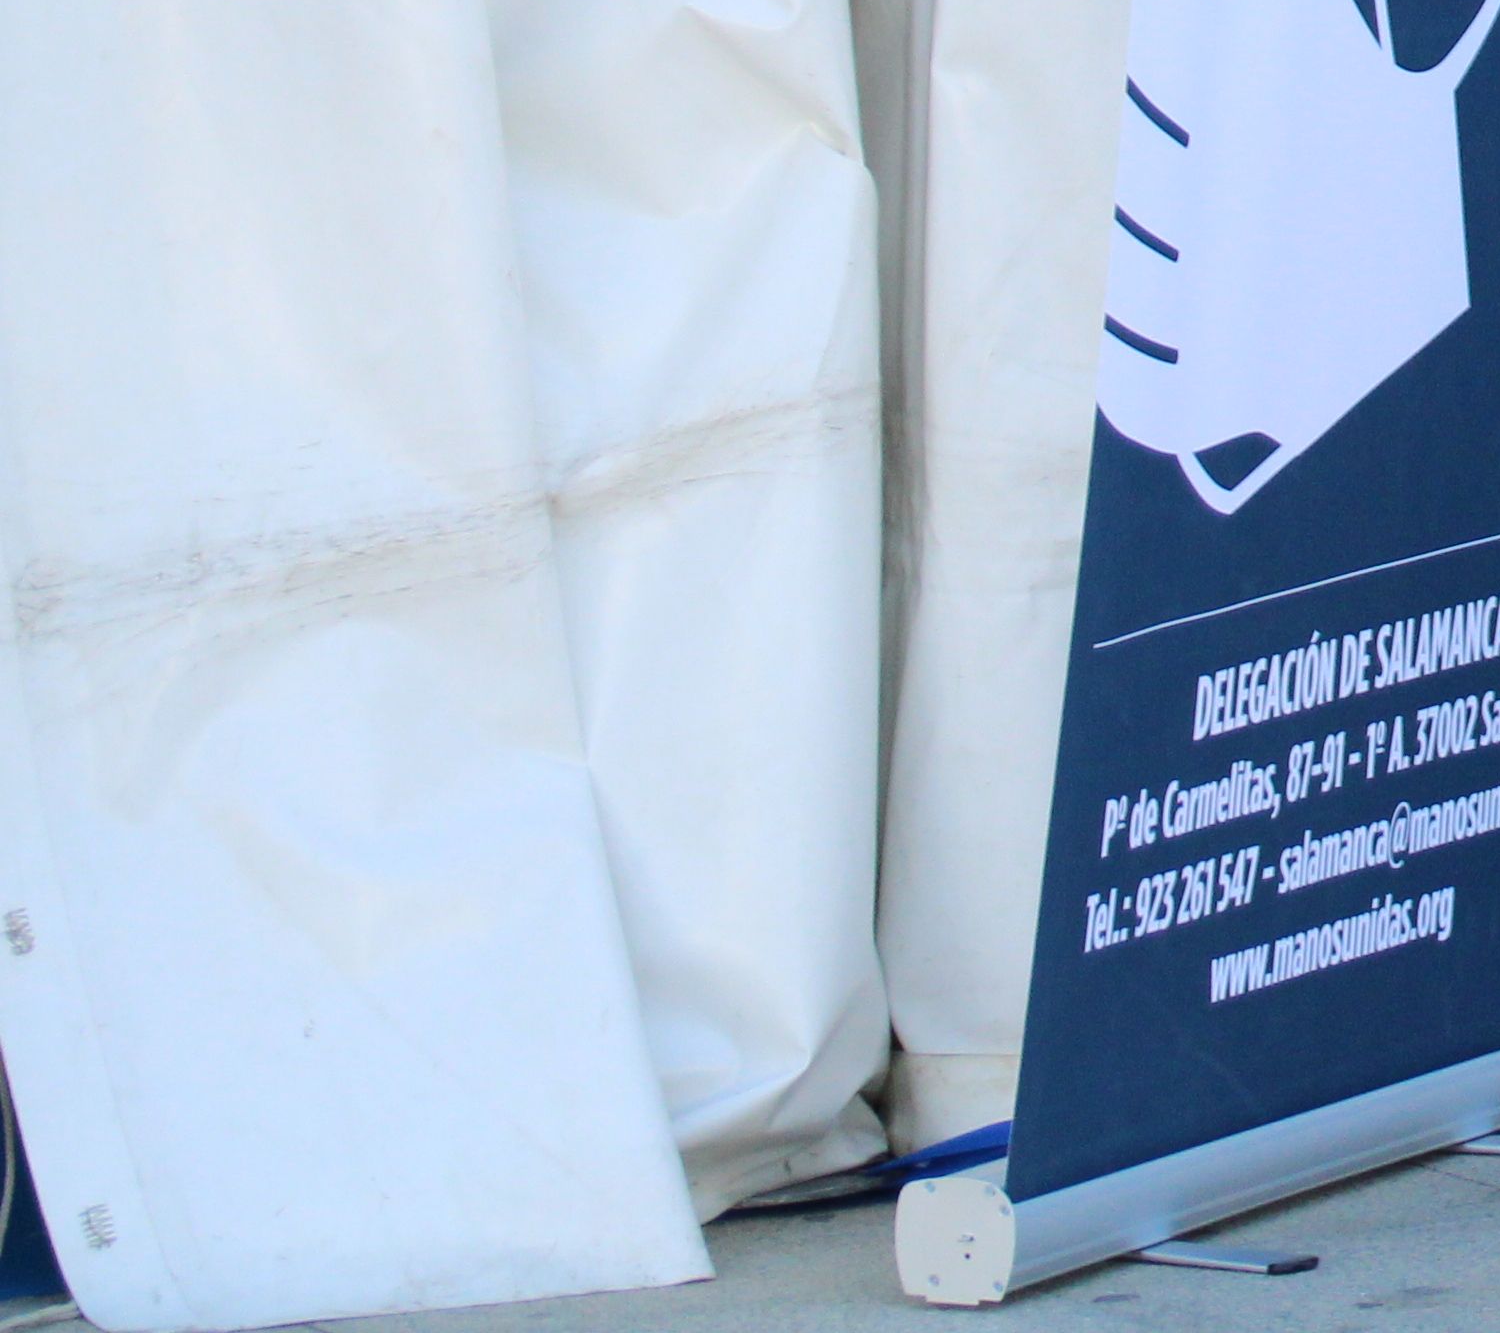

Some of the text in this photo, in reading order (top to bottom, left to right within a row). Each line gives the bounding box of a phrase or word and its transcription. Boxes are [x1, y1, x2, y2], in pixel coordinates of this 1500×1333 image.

[1192, 629, 1337, 742] DELEGACIÓN
[1339, 628, 1374, 699] DE
[1100, 794, 1129, 859] Pº
[1129, 788, 1160, 850] de
[1162, 759, 1282, 839] Carmelitas,
[1285, 731, 1346, 804] 87-91
[1366, 719, 1388, 780] 1º
[1387, 715, 1411, 774] A.
[1413, 694, 1479, 766] 37002
[1083, 887, 1132, 953] Tel.:
[1134, 869, 1178, 939] 923
[1177, 857, 1217, 925] 261
[1216, 844, 1260, 913] 547
[1209, 885, 1456, 1003] www.manosunidas.org
